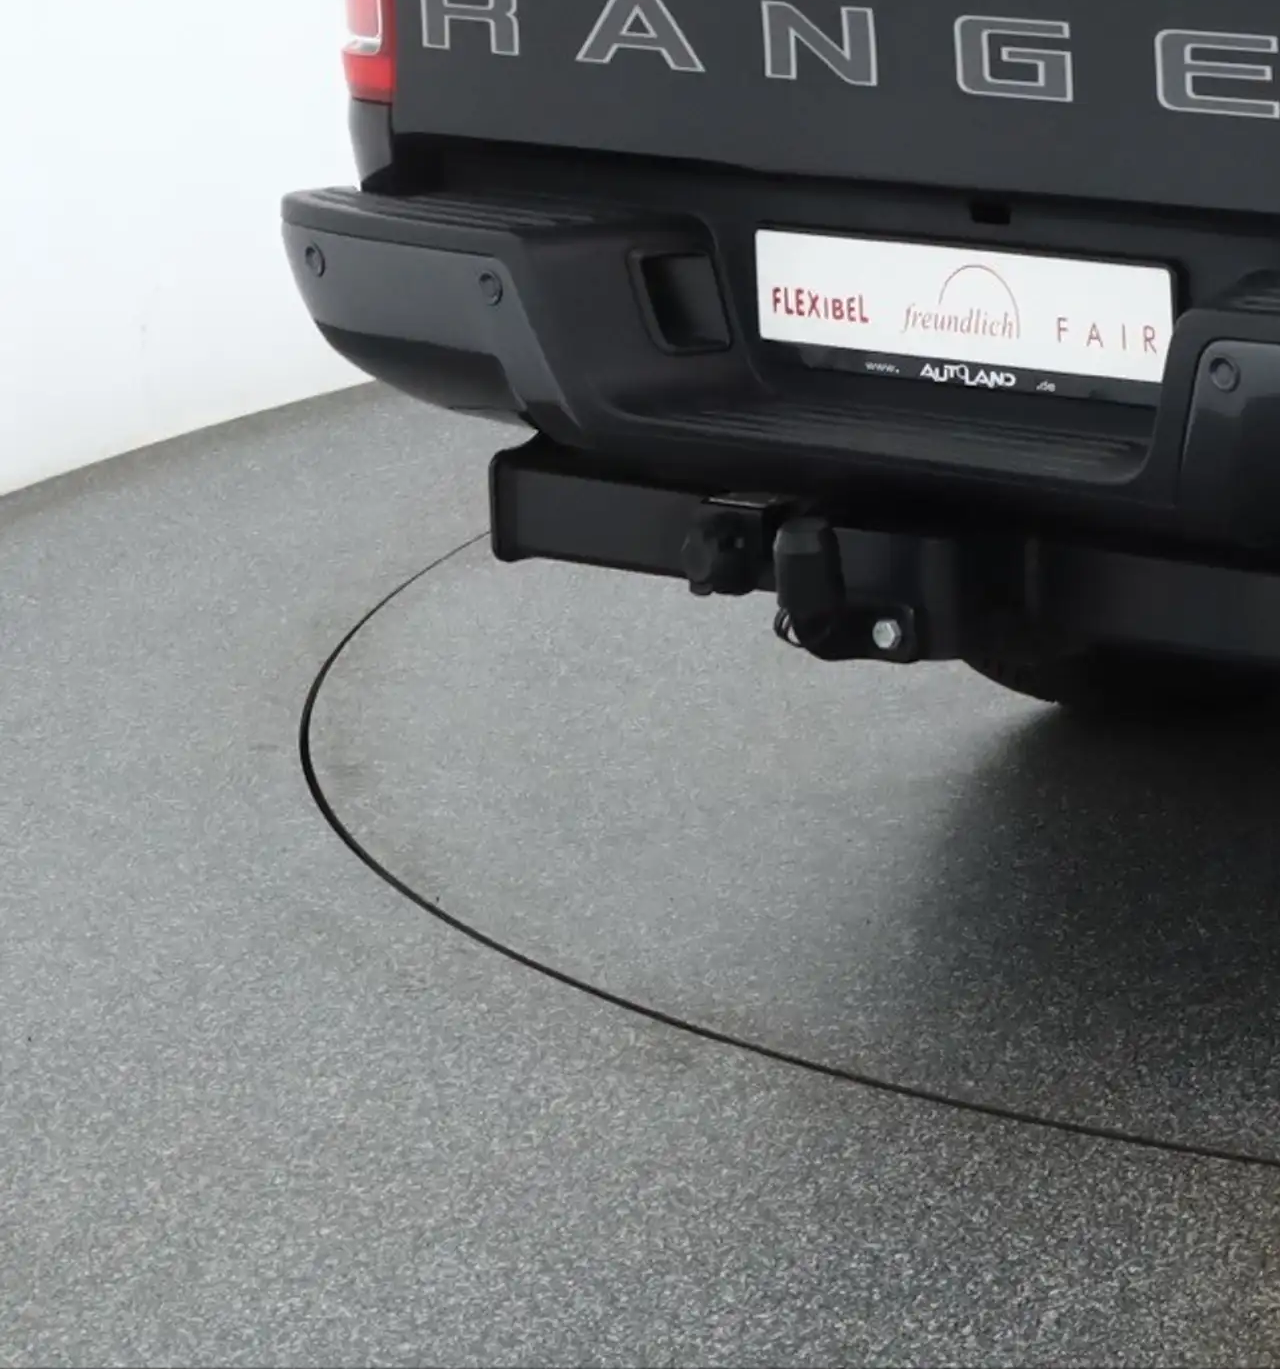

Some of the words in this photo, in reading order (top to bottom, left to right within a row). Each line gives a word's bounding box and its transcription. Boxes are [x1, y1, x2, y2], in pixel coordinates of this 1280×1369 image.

[771, 286, 870, 324] FLEXIBEL
[901, 301, 1014, 339] freundlich
[1056, 316, 1158, 354] FAIR
[919, 362, 1017, 389] AUTOLAND
